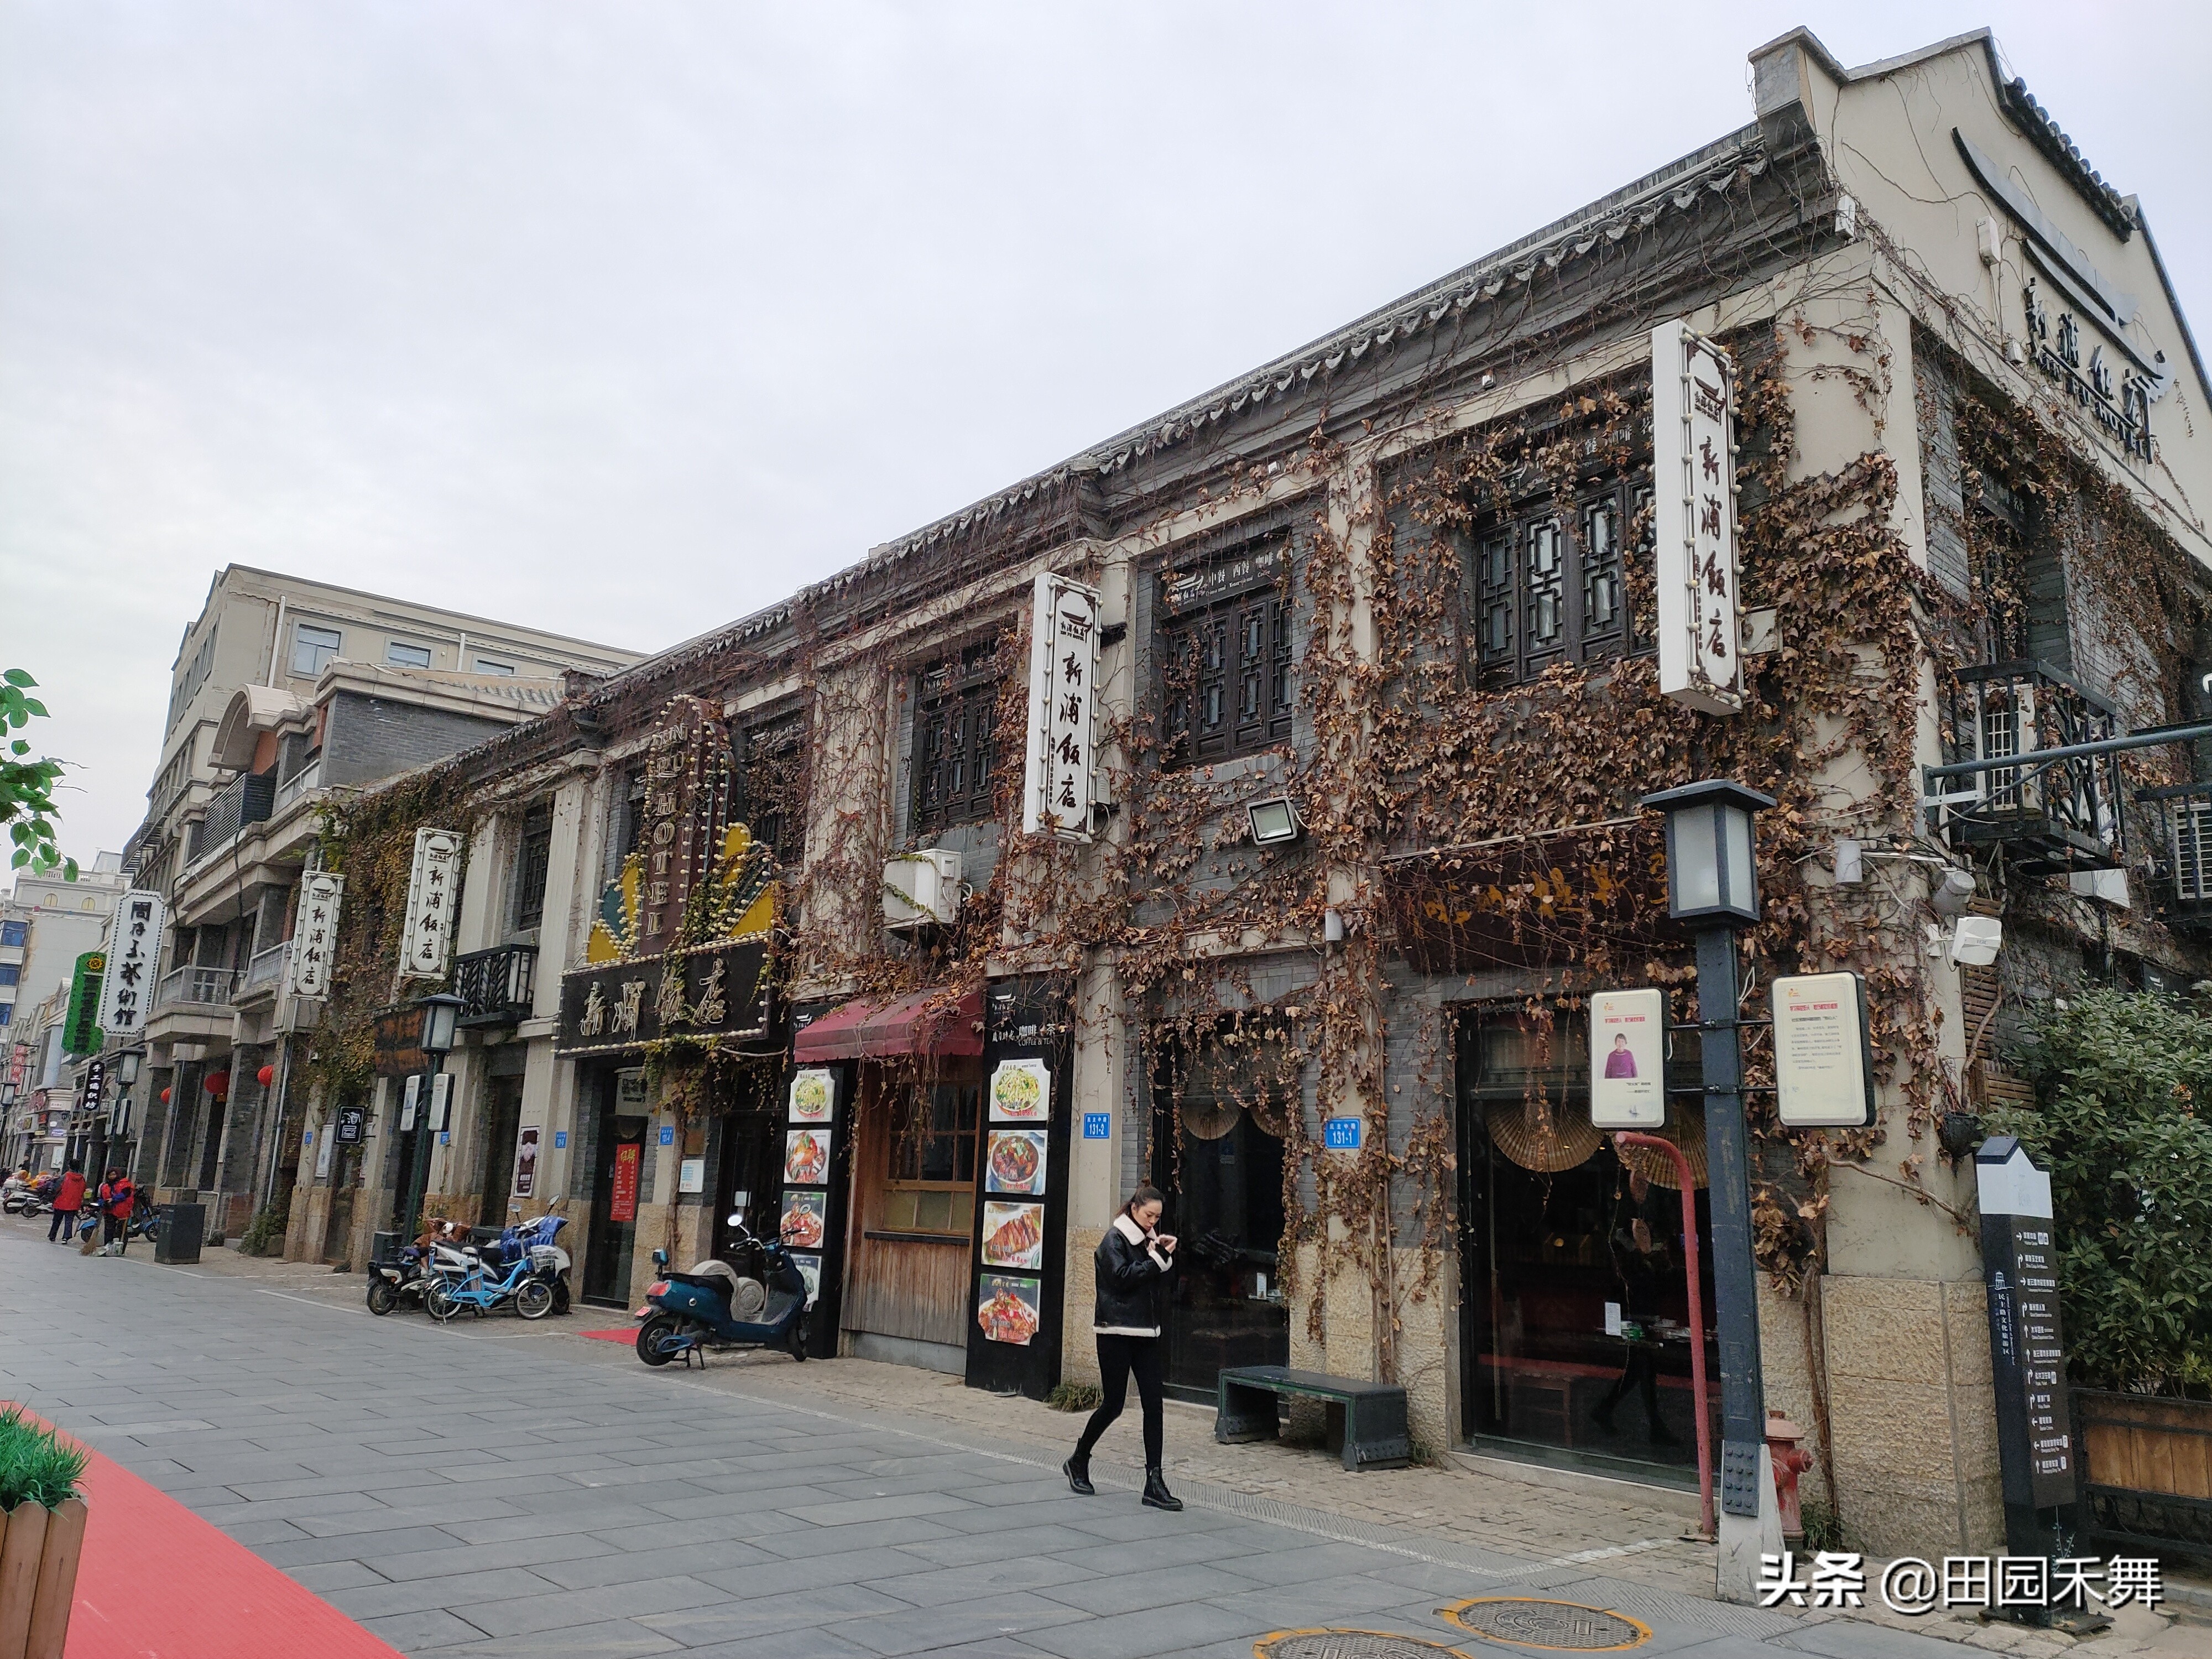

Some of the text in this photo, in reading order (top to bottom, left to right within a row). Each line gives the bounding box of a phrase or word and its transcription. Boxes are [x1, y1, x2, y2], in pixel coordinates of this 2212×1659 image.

[646, 791, 679, 937] HOTEL
[1019, 1024, 1037, 1037] 咖啡
[1089, 1123, 1104, 1135] 131-2
[1333, 1131, 1352, 1144] 131-1
